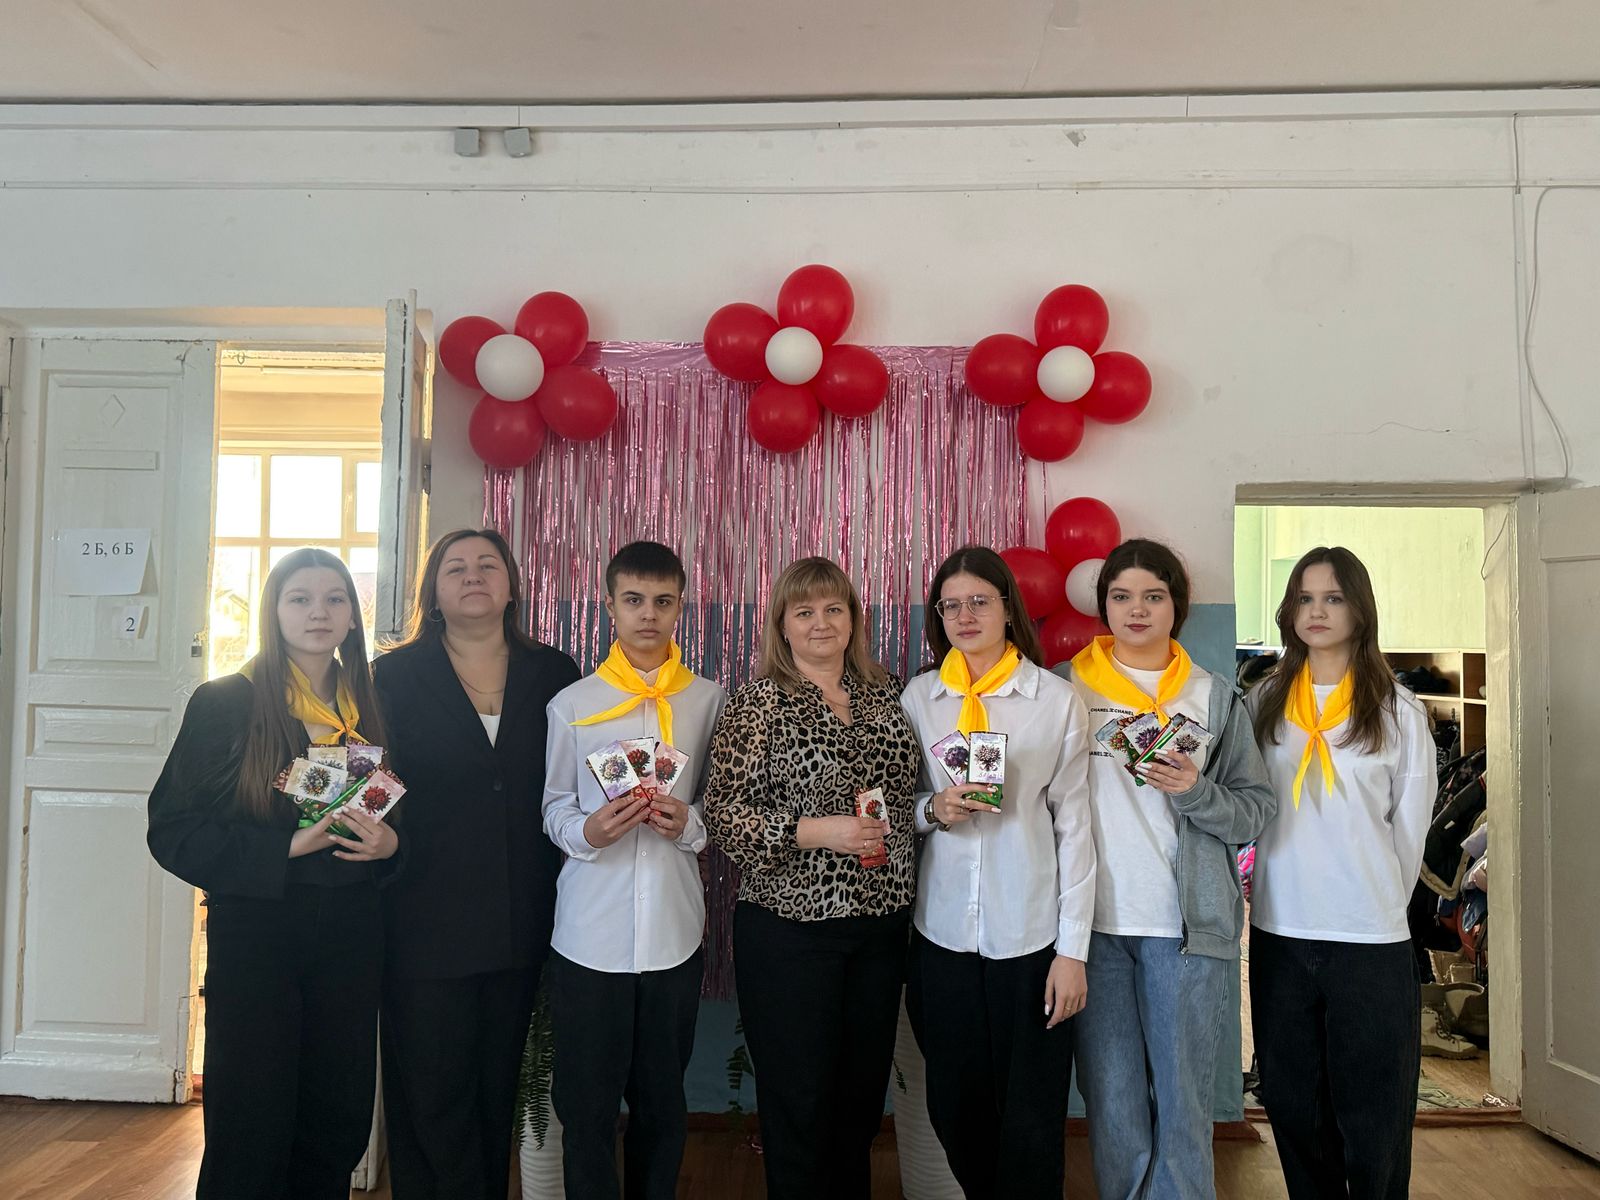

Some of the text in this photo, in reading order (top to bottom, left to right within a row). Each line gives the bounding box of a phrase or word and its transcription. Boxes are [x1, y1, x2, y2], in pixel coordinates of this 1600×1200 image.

[82, 542, 134, 557] 2 Б, 6 Б
[126, 617, 135, 632] 2
